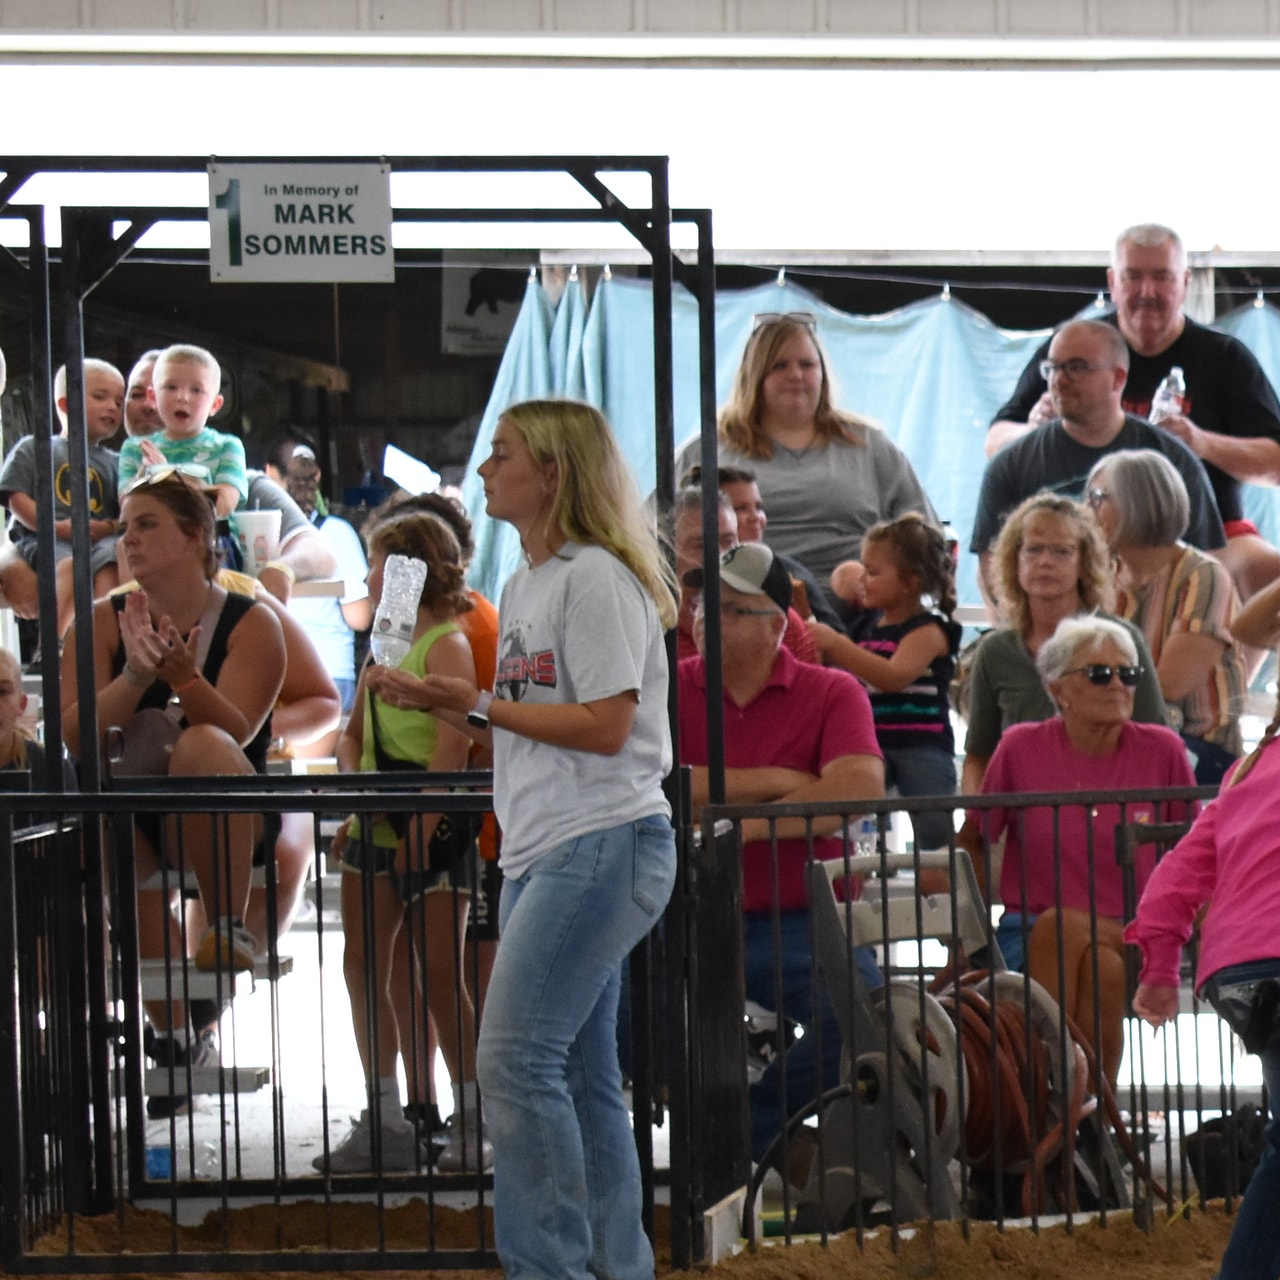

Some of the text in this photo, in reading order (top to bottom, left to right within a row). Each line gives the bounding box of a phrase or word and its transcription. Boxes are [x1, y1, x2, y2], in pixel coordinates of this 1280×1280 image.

[264, 184, 359, 198] In Memory of
[274, 203, 355, 224] MARK
[244, 234, 387, 255] SOMMERS
